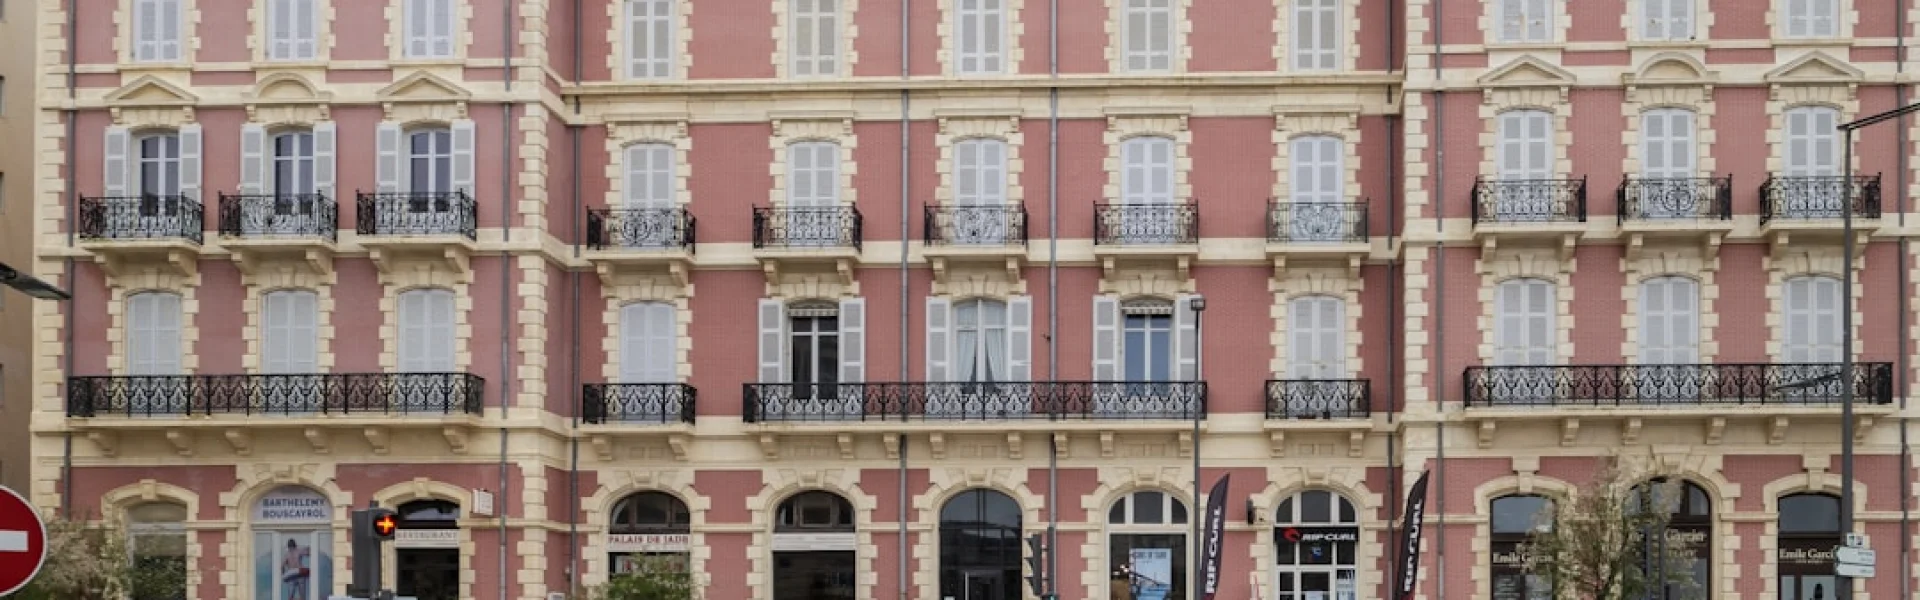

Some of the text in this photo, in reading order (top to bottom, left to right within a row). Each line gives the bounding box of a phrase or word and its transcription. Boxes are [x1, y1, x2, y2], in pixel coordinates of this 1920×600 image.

[608, 535, 643, 544] PALAIS
[646, 535, 660, 544] DE
[1324, 533, 1356, 541] CURL
[1205, 506, 1221, 593] RIP CURL
[1403, 499, 1422, 591] RIP CURL
[1492, 552, 1520, 563] Emile
[1779, 548, 1806, 558] Emile
